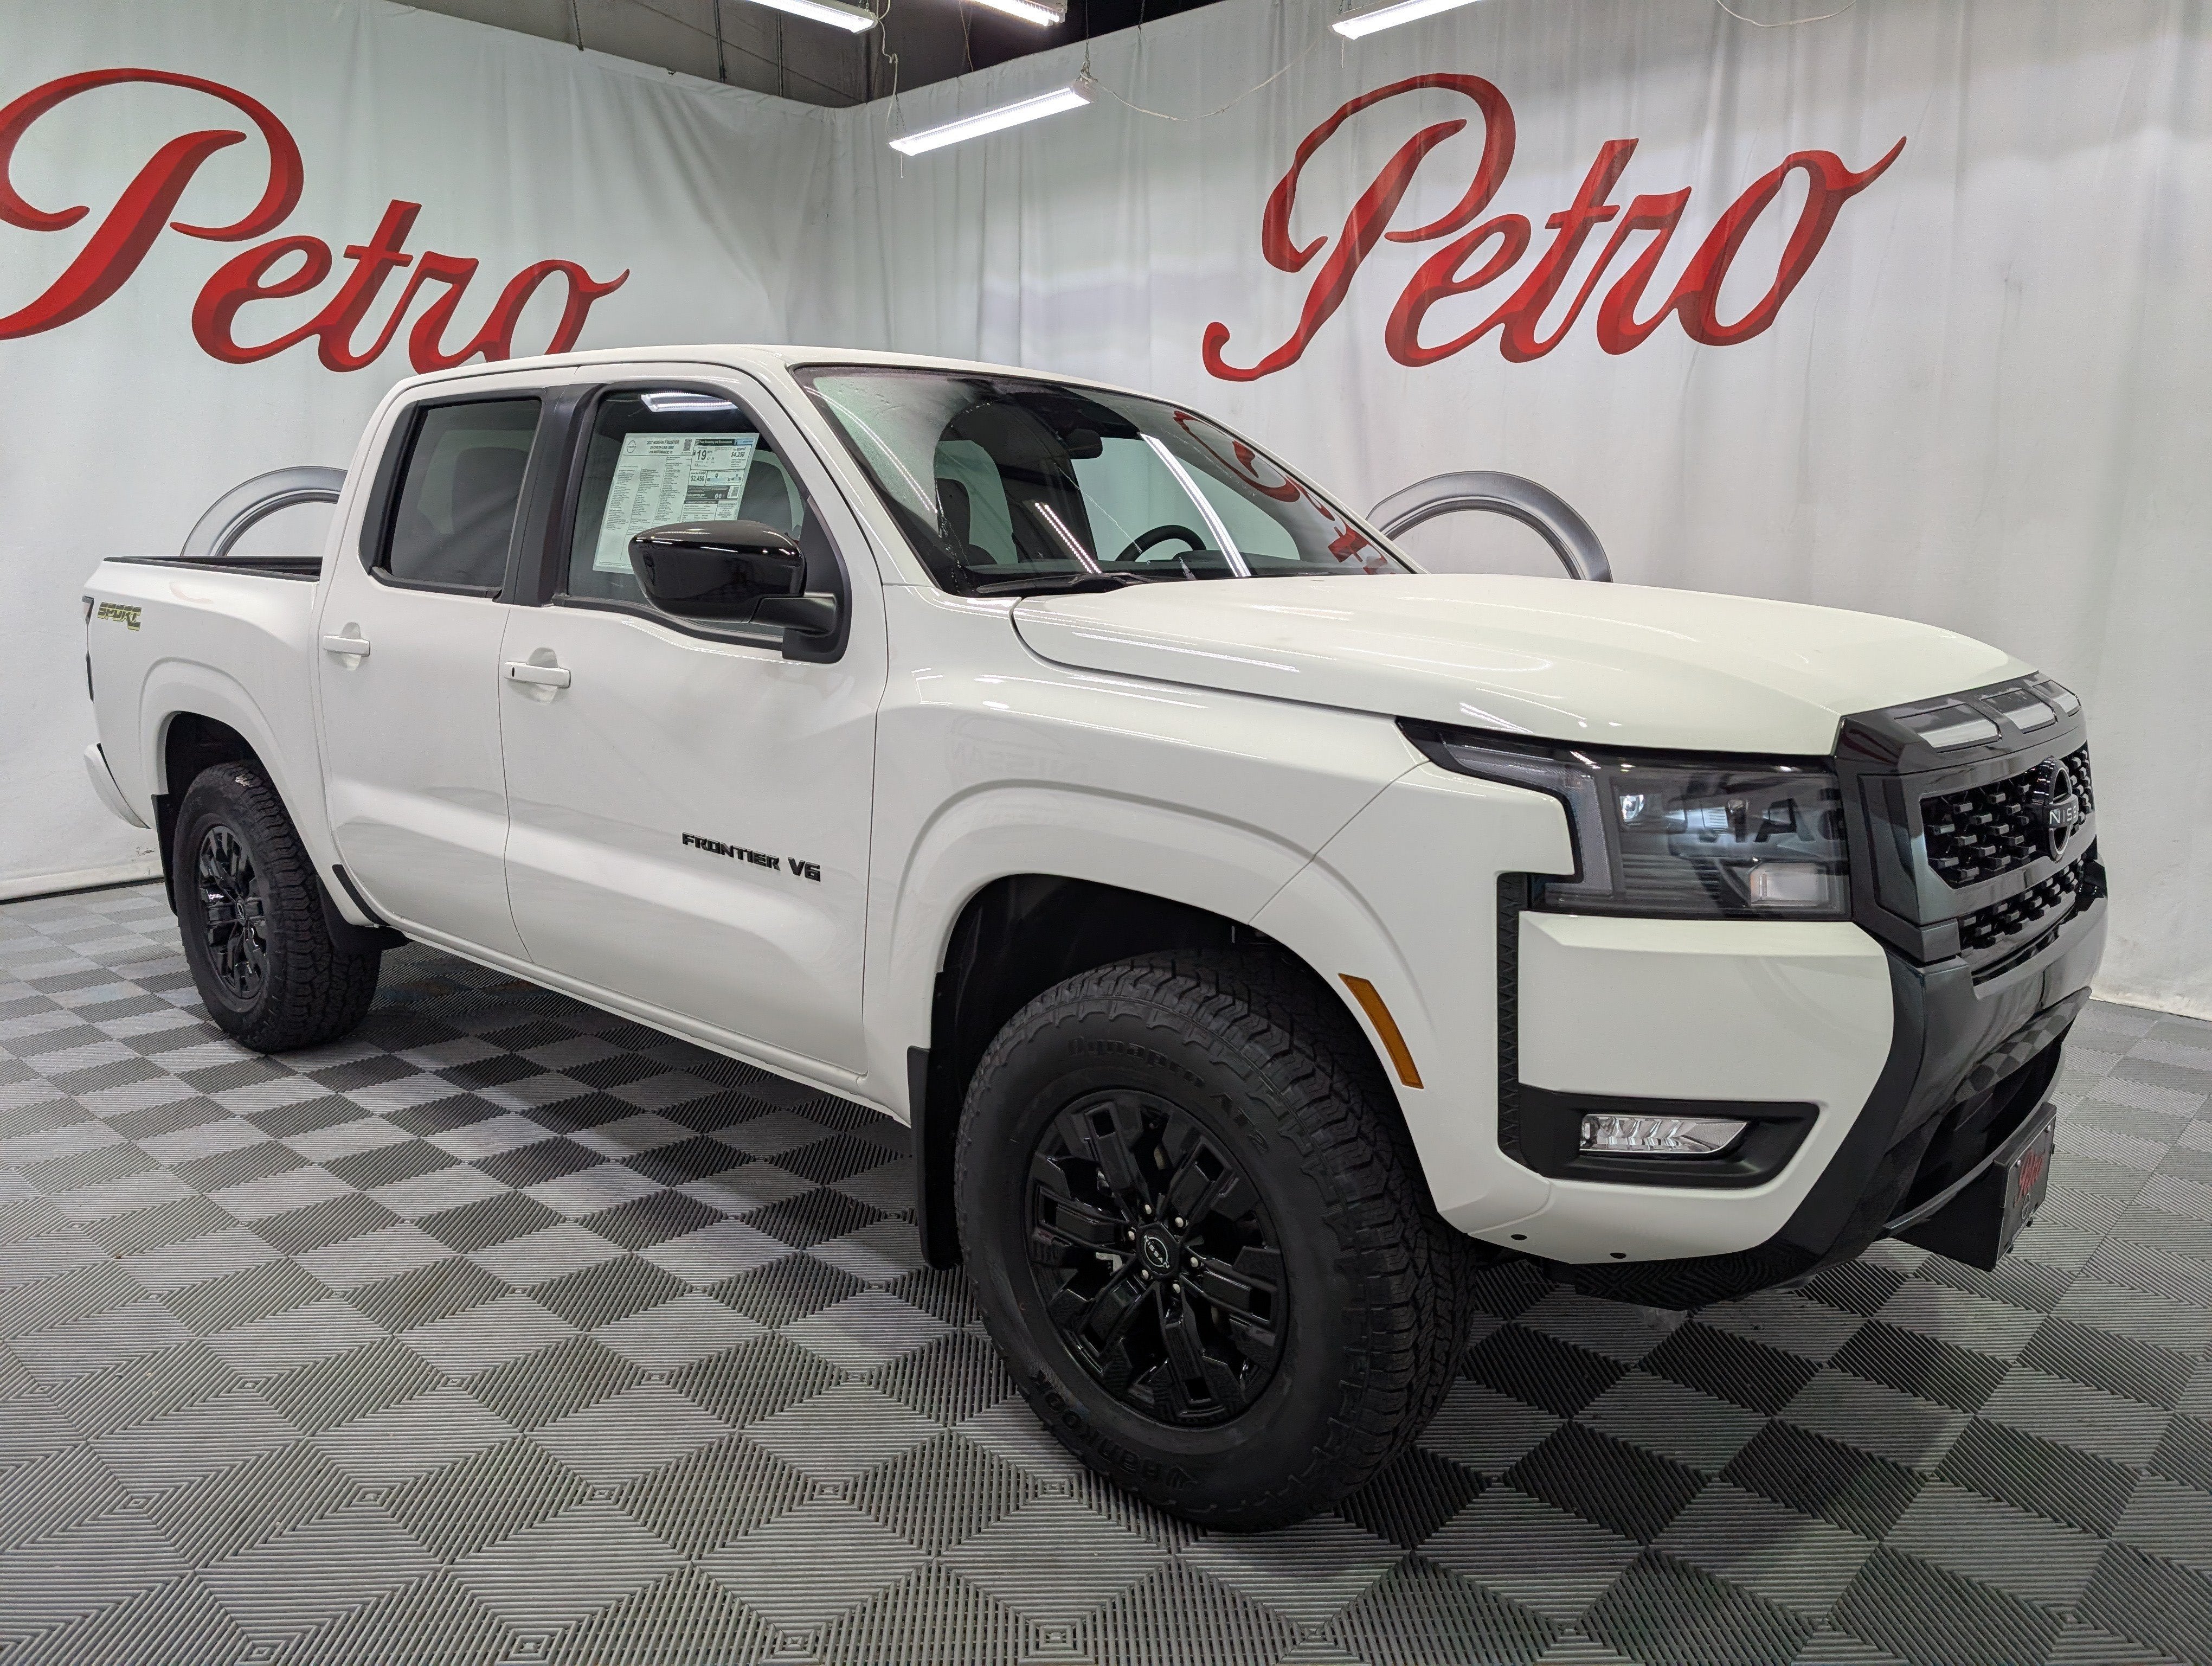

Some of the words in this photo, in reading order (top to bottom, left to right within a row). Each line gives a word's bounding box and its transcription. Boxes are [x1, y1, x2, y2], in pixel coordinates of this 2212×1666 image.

[0, 68, 630, 374] Petro
[1203, 73, 1907, 382] Petro
[697, 450, 707, 460] 19
[682, 832, 781, 871] FRONTIER
[788, 856, 820, 882] V6
[1143, 1235, 1171, 1269] NISSAN
